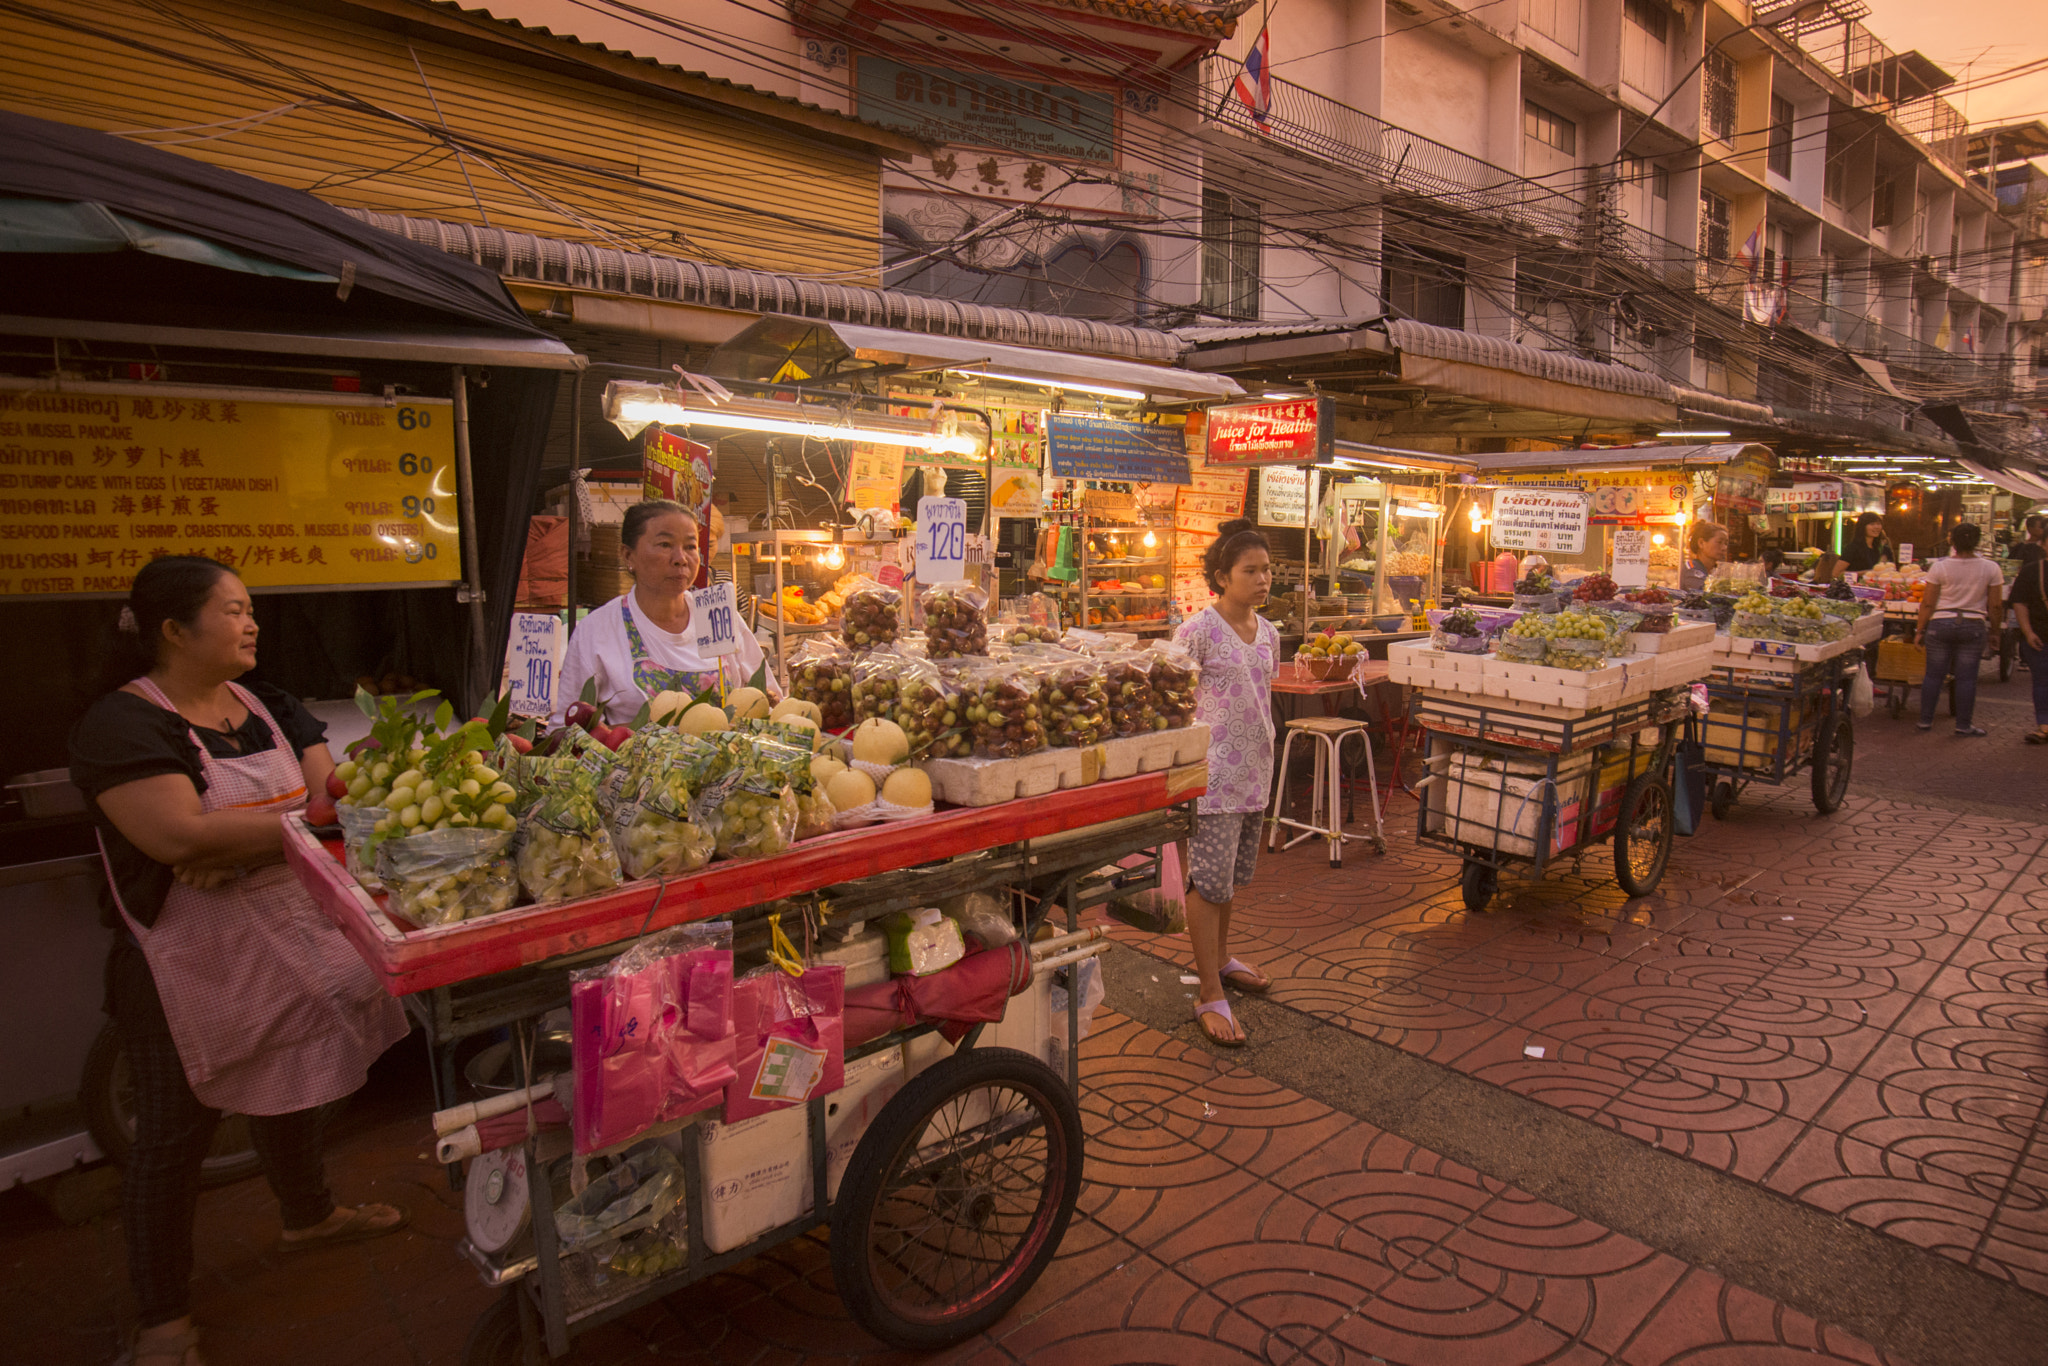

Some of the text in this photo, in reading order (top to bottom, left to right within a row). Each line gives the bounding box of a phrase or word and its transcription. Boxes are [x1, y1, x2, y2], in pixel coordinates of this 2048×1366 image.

[397, 407, 431, 431] 60
[1212, 417, 1313, 442] Juice for Health
[27, 423, 75, 439] MUSSEL
[79, 425, 133, 440] PANCAKE
[398, 453, 433, 476] 60
[20, 474, 61, 489] TURNIP
[65, 474, 97, 489] CAKE
[102, 475, 132, 490] WITH
[135, 476, 166, 491] EGGS
[401, 495, 436, 518] 90
[0, 524, 60, 539] SEAFOOD
[63, 524, 120, 539] PANCAKE
[304, 523, 349, 537] MUSSELS
[352, 523, 372, 537] AND
[928, 521, 965, 560] 120
[404, 540, 438, 564] 90
[1556, 542, 1573, 550] บาท
[21, 577, 74, 593] OYSTER
[83, 575, 137, 592] PANCAK
[526, 657, 552, 700] 100
